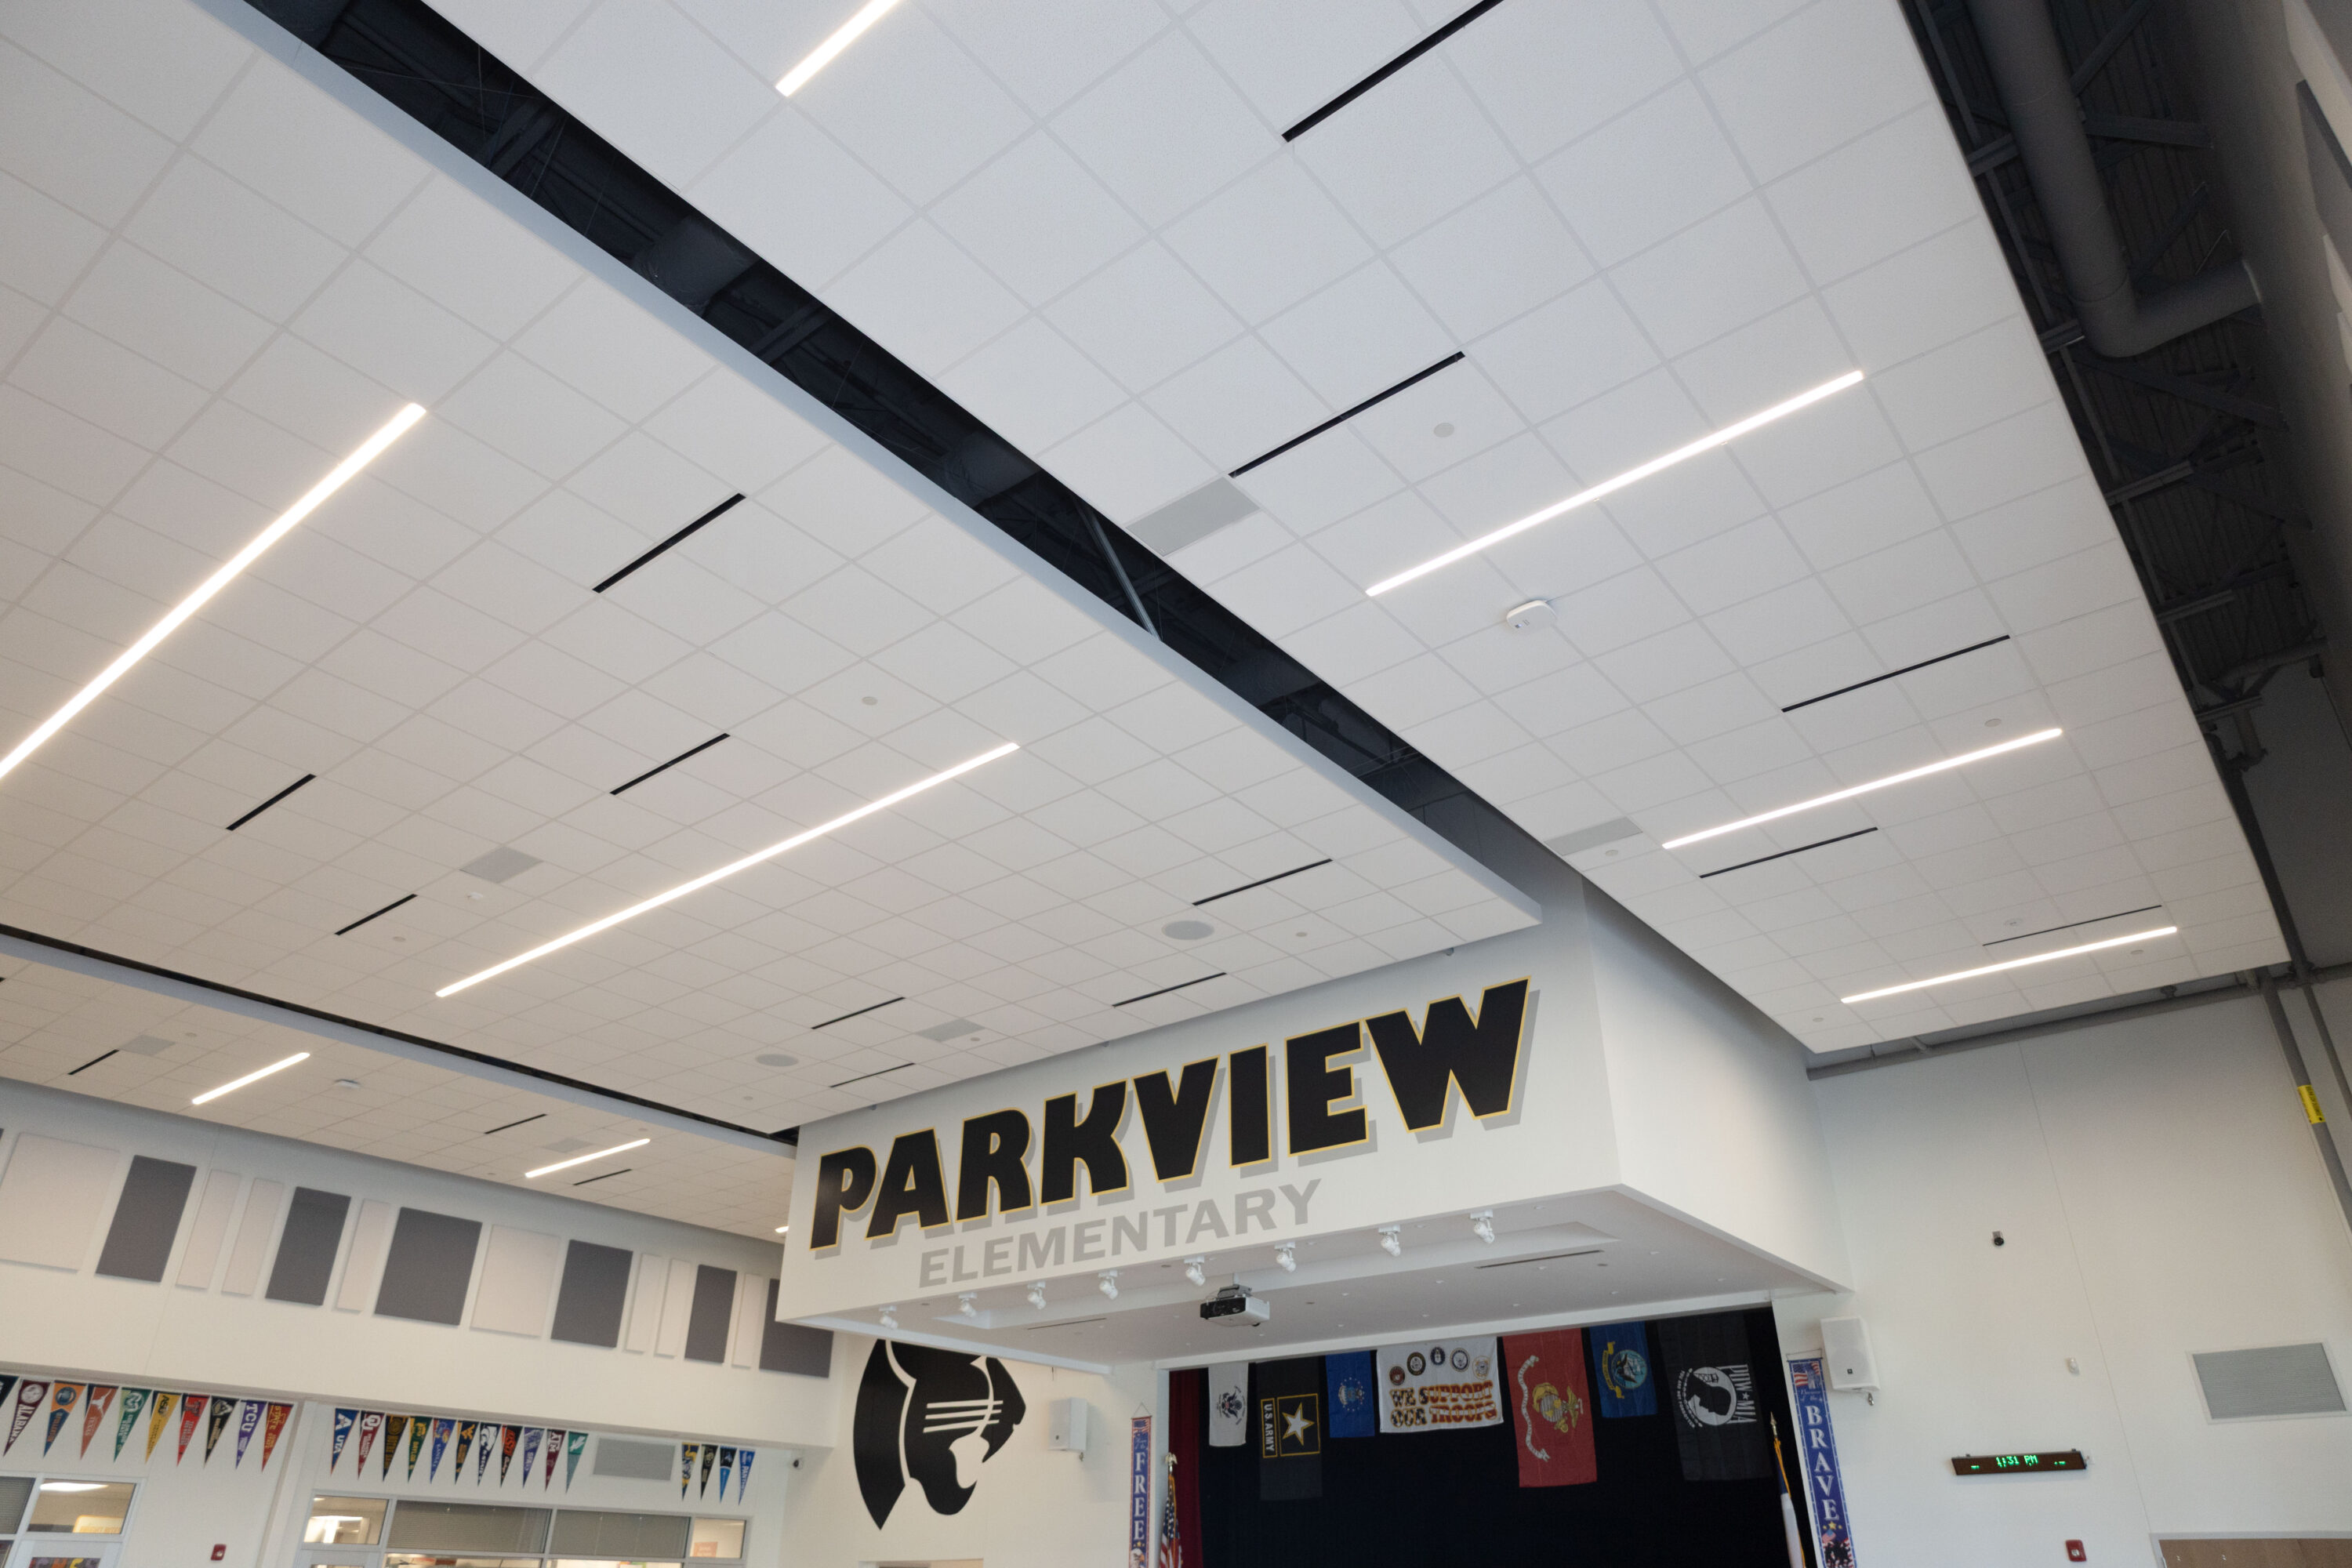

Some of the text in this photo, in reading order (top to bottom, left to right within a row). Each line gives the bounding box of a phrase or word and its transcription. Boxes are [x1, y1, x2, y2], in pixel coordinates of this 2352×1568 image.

[809, 975, 1535, 1254] PARKVIEW
[919, 1178, 1322, 1288] ELEMENTARY
[1389, 1380, 1494, 1408] WE SUPPORT
[1715, 1364, 1757, 1424] POW MIA
[9, 1403, 36, 1443] ALABAMA
[241, 1403, 258, 1432] TCU
[1391, 1401, 1497, 1428] OUR TROOPS
[334, 1436, 345, 1454] UTA
[1805, 1404, 1839, 1521] BRAVE
[1995, 1454, 2038, 1467] 1:31 PM
[1134, 1452, 1146, 1541] FREE
